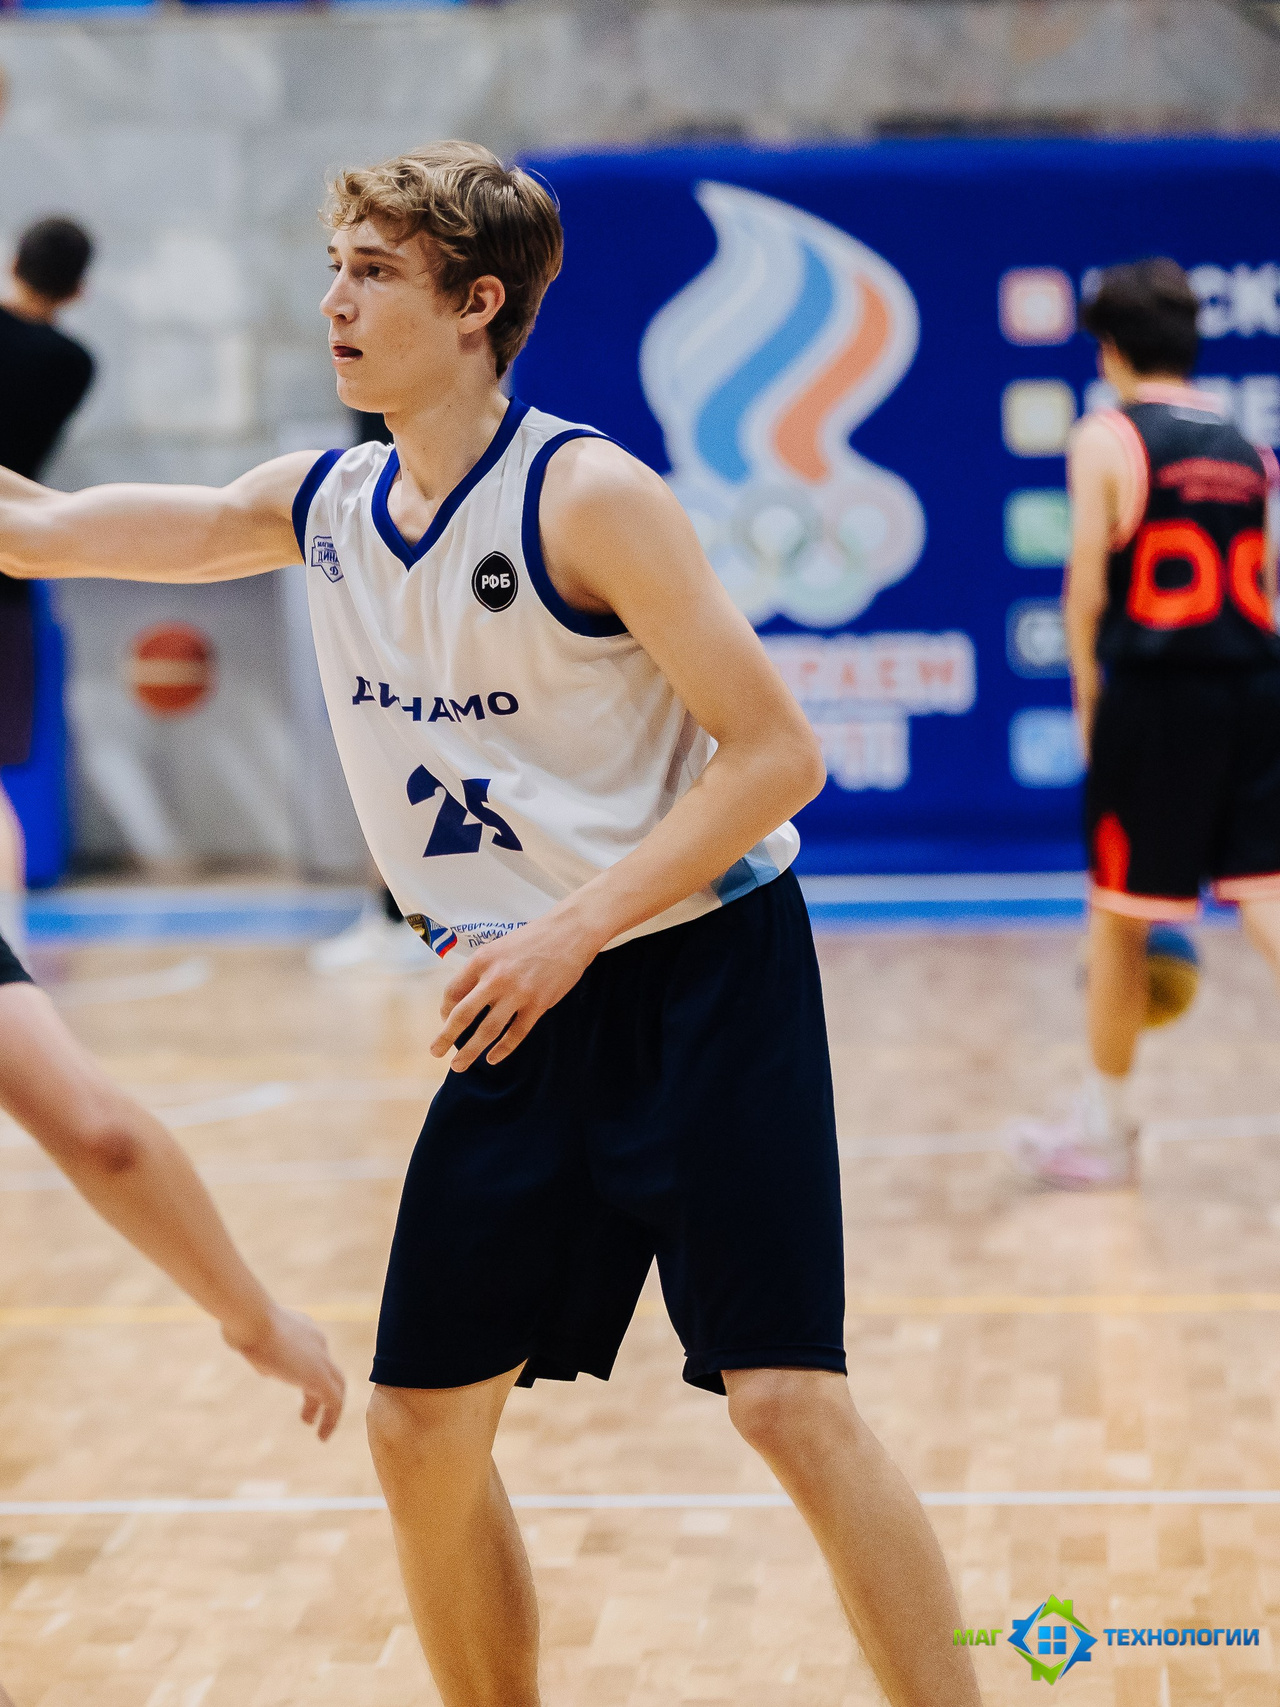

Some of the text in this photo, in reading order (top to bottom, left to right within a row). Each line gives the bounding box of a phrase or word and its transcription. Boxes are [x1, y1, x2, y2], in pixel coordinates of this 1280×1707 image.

[481, 573, 511, 589] РФБ
[352, 676, 519, 723] ДИНАМО
[406, 763, 524, 858] 25
